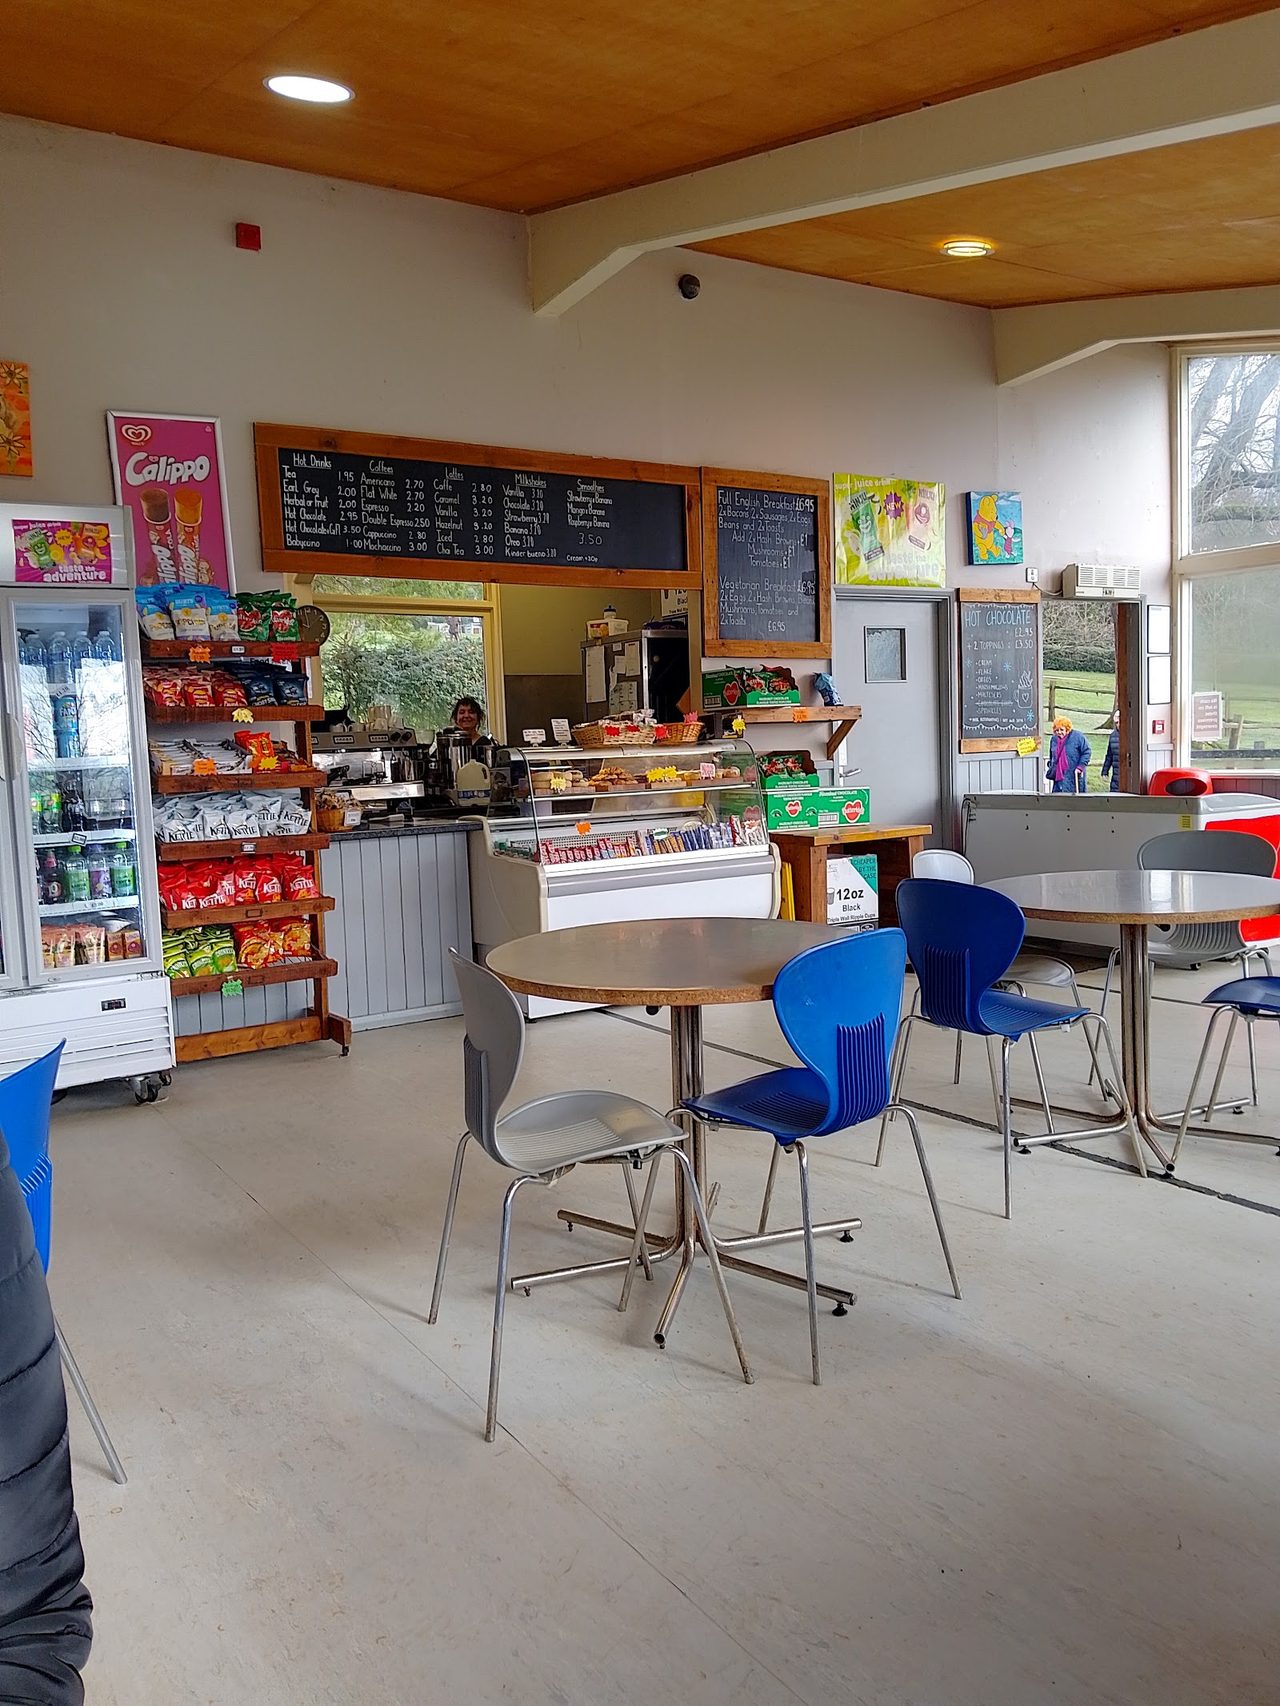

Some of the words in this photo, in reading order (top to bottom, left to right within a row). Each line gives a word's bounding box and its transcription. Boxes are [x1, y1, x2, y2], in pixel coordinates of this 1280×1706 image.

[293, 453, 306, 466] Hot
[310, 454, 332, 468] Drinks
[369, 460, 394, 473] Coffees
[125, 451, 210, 487] Calippo
[282, 465, 296, 478] Tea
[338, 471, 354, 481] 1.95
[445, 467, 464, 480] Lattes
[360, 472, 395, 487] Americano
[405, 479, 424, 489] 2.70
[433, 478, 452, 491] Caffe
[515, 473, 547, 488] Milkshakes
[577, 479, 605, 492] Smoothies
[283, 479, 299, 493] Earl
[303, 481, 320, 497] Grey
[338, 486, 356, 497] 2.00
[360, 485, 375, 498] Flat
[378, 487, 398, 500] White
[406, 491, 424, 500] 2.70
[502, 484, 525, 497] Vanilla
[284, 493, 306, 506] Herbal
[339, 500, 356, 508] 2.00
[434, 491, 460, 505] Caramel
[472, 495, 493, 505] 3.20
[503, 497, 530, 510] Chocolate
[595, 492, 612, 505] Banana
[718, 490, 732, 505] Full
[735, 492, 760, 510] English
[763, 494, 795, 510] Breakfast
[361, 498, 389, 514] Espresso
[407, 502, 425, 512] 2.20
[434, 504, 458, 517] Vanilla
[567, 502, 585, 517] Mango
[886, 502, 901, 510] NEW
[284, 506, 296, 519] Hot
[300, 507, 327, 521] Chocolate
[340, 511, 358, 521] 2.95
[362, 512, 388, 525] Double
[390, 514, 414, 528] Espresso
[504, 509, 538, 525] Strawberry
[285, 520, 298, 533] Hot
[342, 525, 361, 534] 3.50
[435, 516, 463, 530] Hazelnut
[504, 522, 528, 534] Banana
[718, 516, 740, 530] Beans
[742, 520, 755, 531] and
[363, 525, 397, 540] Cappuccino
[408, 531, 426, 540] 2.80
[436, 529, 453, 542] Iced
[578, 532, 603, 545] 3.50
[731, 530, 745, 542] Add
[756, 532, 772, 544] Hash
[775, 533, 797, 546] Browns
[505, 534, 520, 546] Oreo
[452, 543, 464, 556] Tea
[505, 546, 526, 557] Kinder
[748, 543, 784, 556] Mushrooms
[748, 555, 779, 568] Tomatoes
[59, 565, 83, 573] taste
[43, 570, 106, 582] adventure
[719, 576, 760, 590] Vegetarian
[764, 578, 796, 592] Breakfast
[787, 605, 799, 616] and
[965, 610, 981, 627] HOT
[986, 609, 1031, 626] CHOCOLATE
[768, 620, 786, 632] £6.95
[1015, 627, 1033, 637] £2.95
[974, 641, 978, 650] 2
[980, 641, 1004, 650] TOPPINGS
[1015, 639, 1033, 649] £3.50
[284, 811, 309, 827] KETTLE
[232, 824, 258, 836] KETTLE
[290, 878, 314, 891] KETTLE
[836, 888, 864, 901] 12oz
[199, 894, 225, 909] KETTLE
[842, 903, 861, 912] Black
